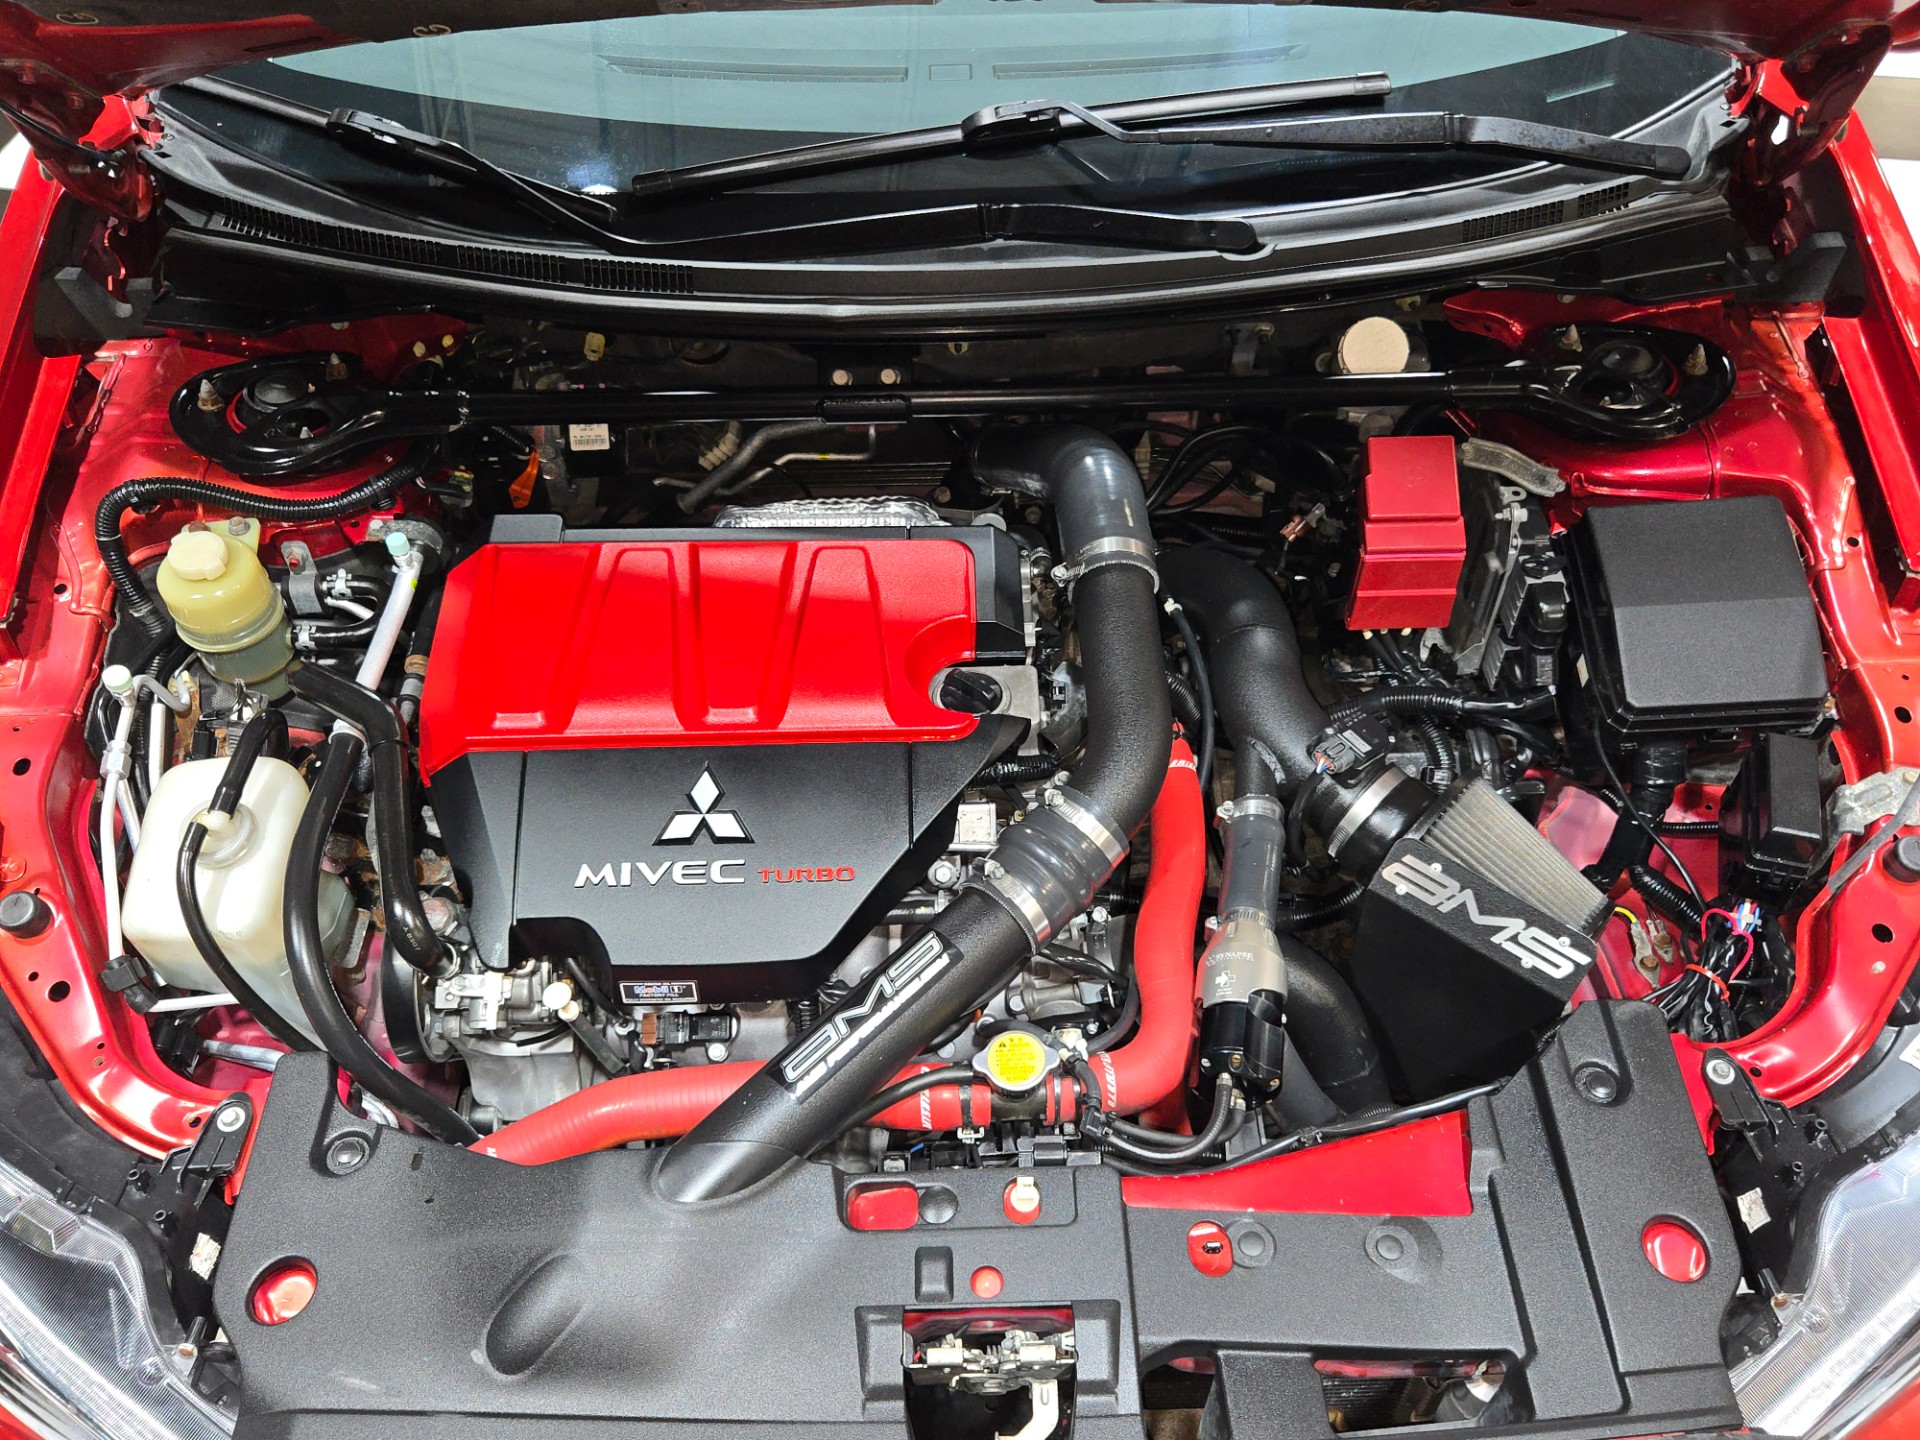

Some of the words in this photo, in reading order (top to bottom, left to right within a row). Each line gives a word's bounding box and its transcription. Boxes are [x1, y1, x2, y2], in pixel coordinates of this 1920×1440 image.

[574, 859, 746, 888] MIVEC
[757, 866, 856, 883] TURBO
[1215, 951, 1254, 960] SYNAPSE
[633, 985, 669, 994] Mobil
